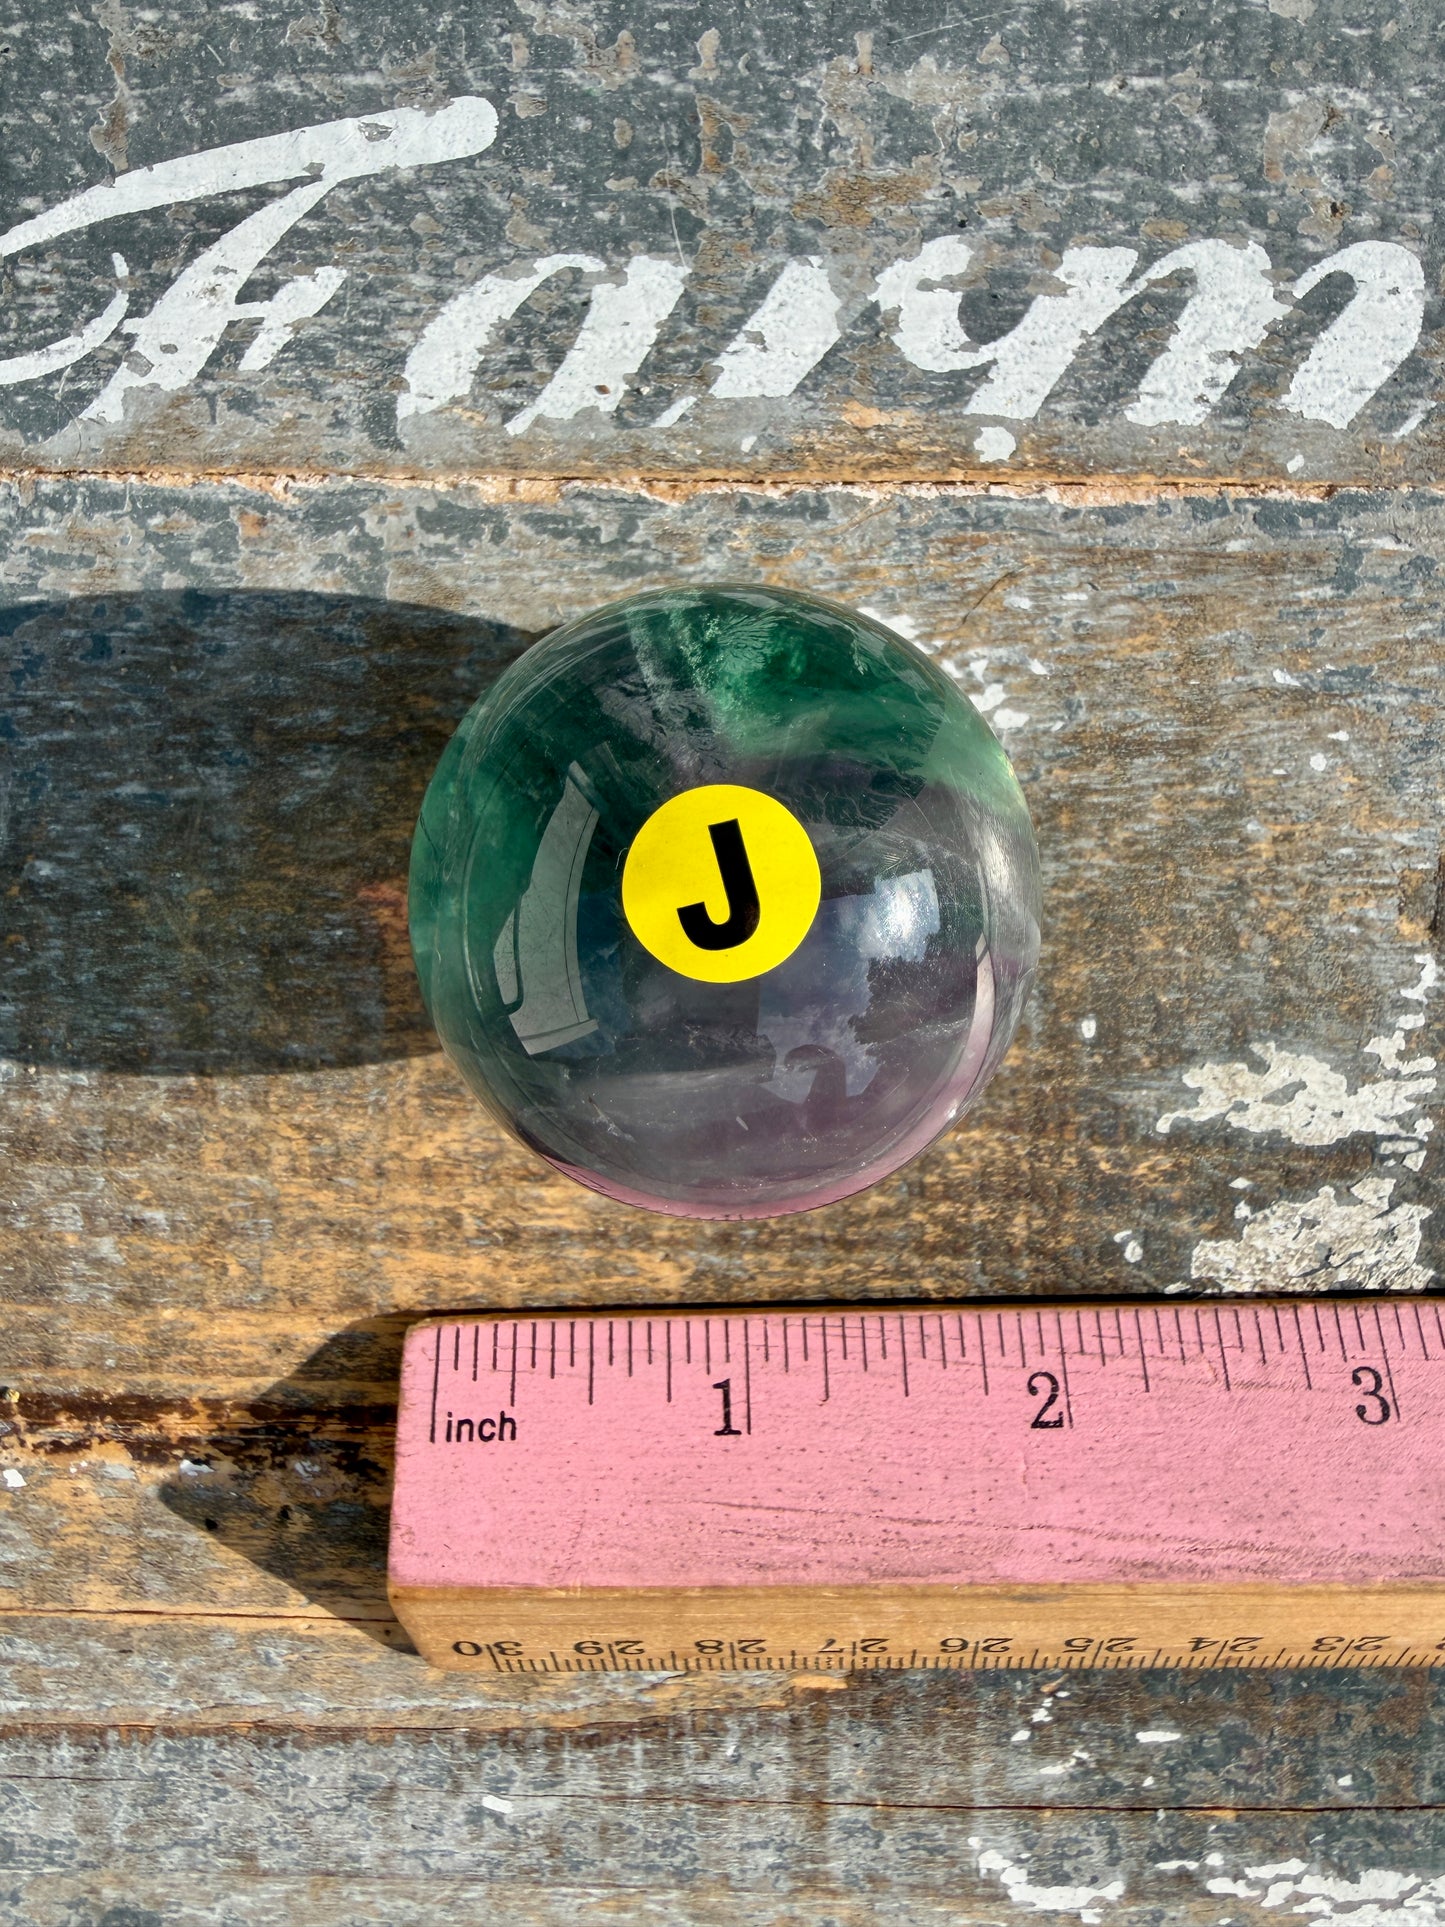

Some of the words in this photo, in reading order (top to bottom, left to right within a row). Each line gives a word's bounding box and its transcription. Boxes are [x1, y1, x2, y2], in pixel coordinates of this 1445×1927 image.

[676, 817, 761, 951] J
[445, 1411, 517, 1443] inch
[713, 1378, 742, 1437] 1
[1027, 1371, 1065, 1429] 2
[1351, 1366, 1391, 1425] 3
[452, 1640, 524, 1657] 30
[573, 1640, 645, 1656] 29
[694, 1638, 767, 1655] 28
[818, 1638, 890, 1654] 27
[939, 1637, 1013, 1653] 26
[1062, 1637, 1139, 1654] 25
[1187, 1636, 1264, 1653] 24
[1311, 1635, 1392, 1652] 23
